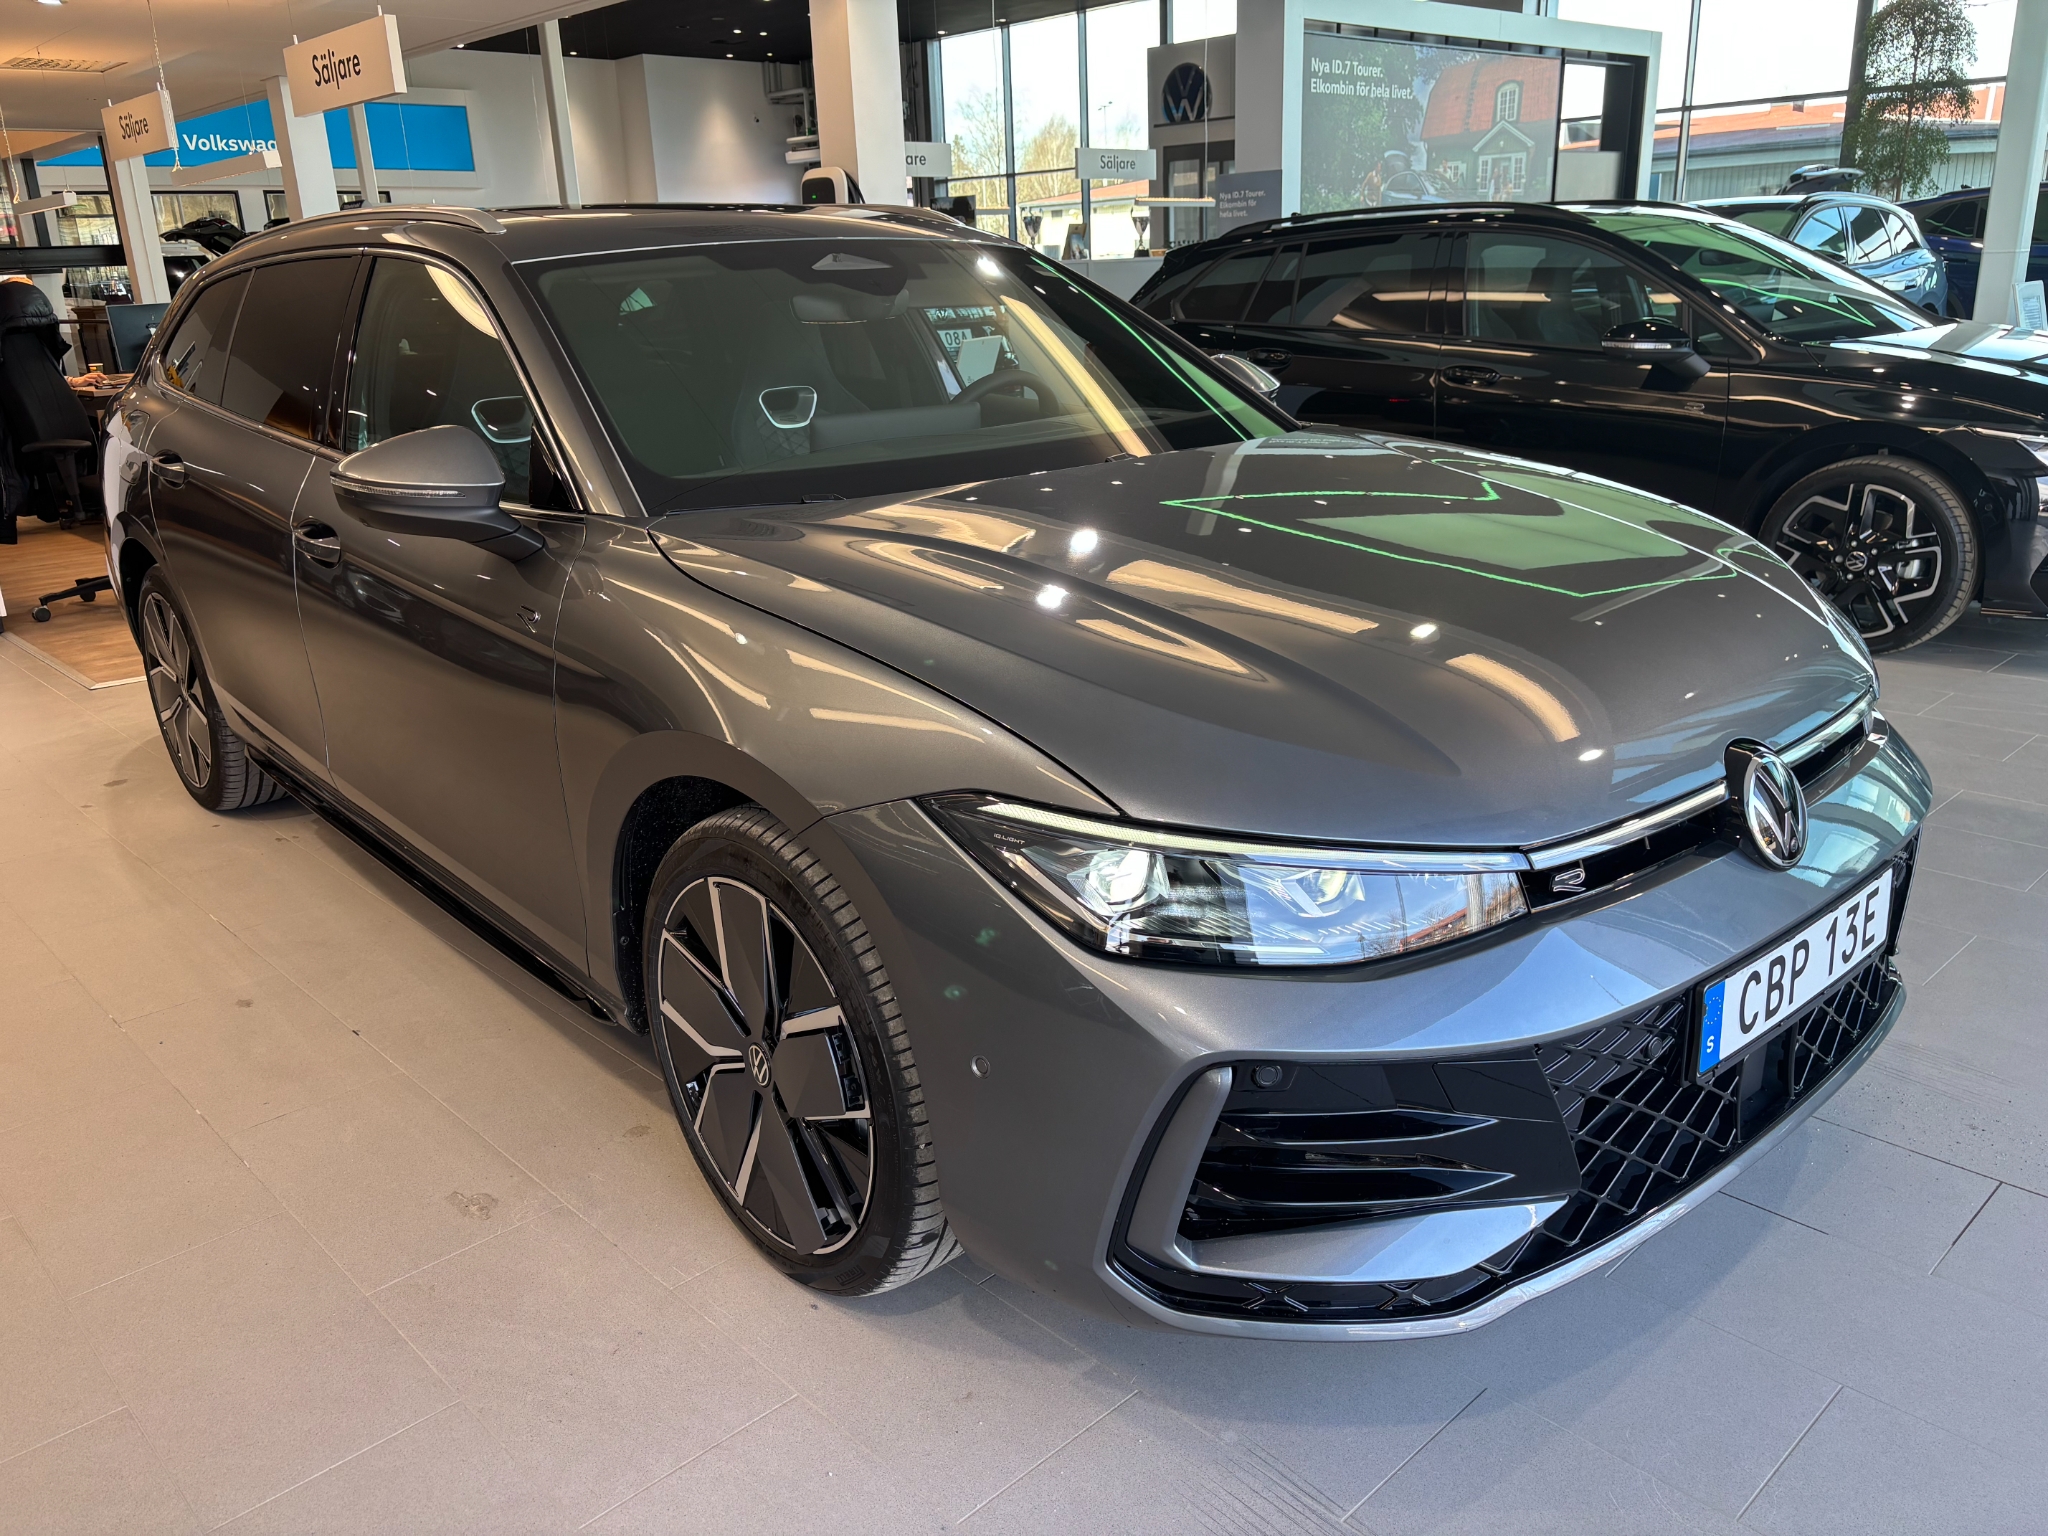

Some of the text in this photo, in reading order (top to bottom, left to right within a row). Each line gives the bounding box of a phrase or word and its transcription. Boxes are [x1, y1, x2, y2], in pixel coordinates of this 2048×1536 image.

[311, 48, 362, 90] Säljare
[1311, 57, 1384, 78] Nya ID.7 Tourer.
[1162, 62, 1213, 123] VW
[1310, 78, 1414, 100] Elkombin för hela livet.
[119, 112, 149, 143] Säljare
[1100, 154, 1136, 173] Säljare
[1739, 885, 1880, 1035] CBP 13E
[1706, 1035, 1716, 1053] S
